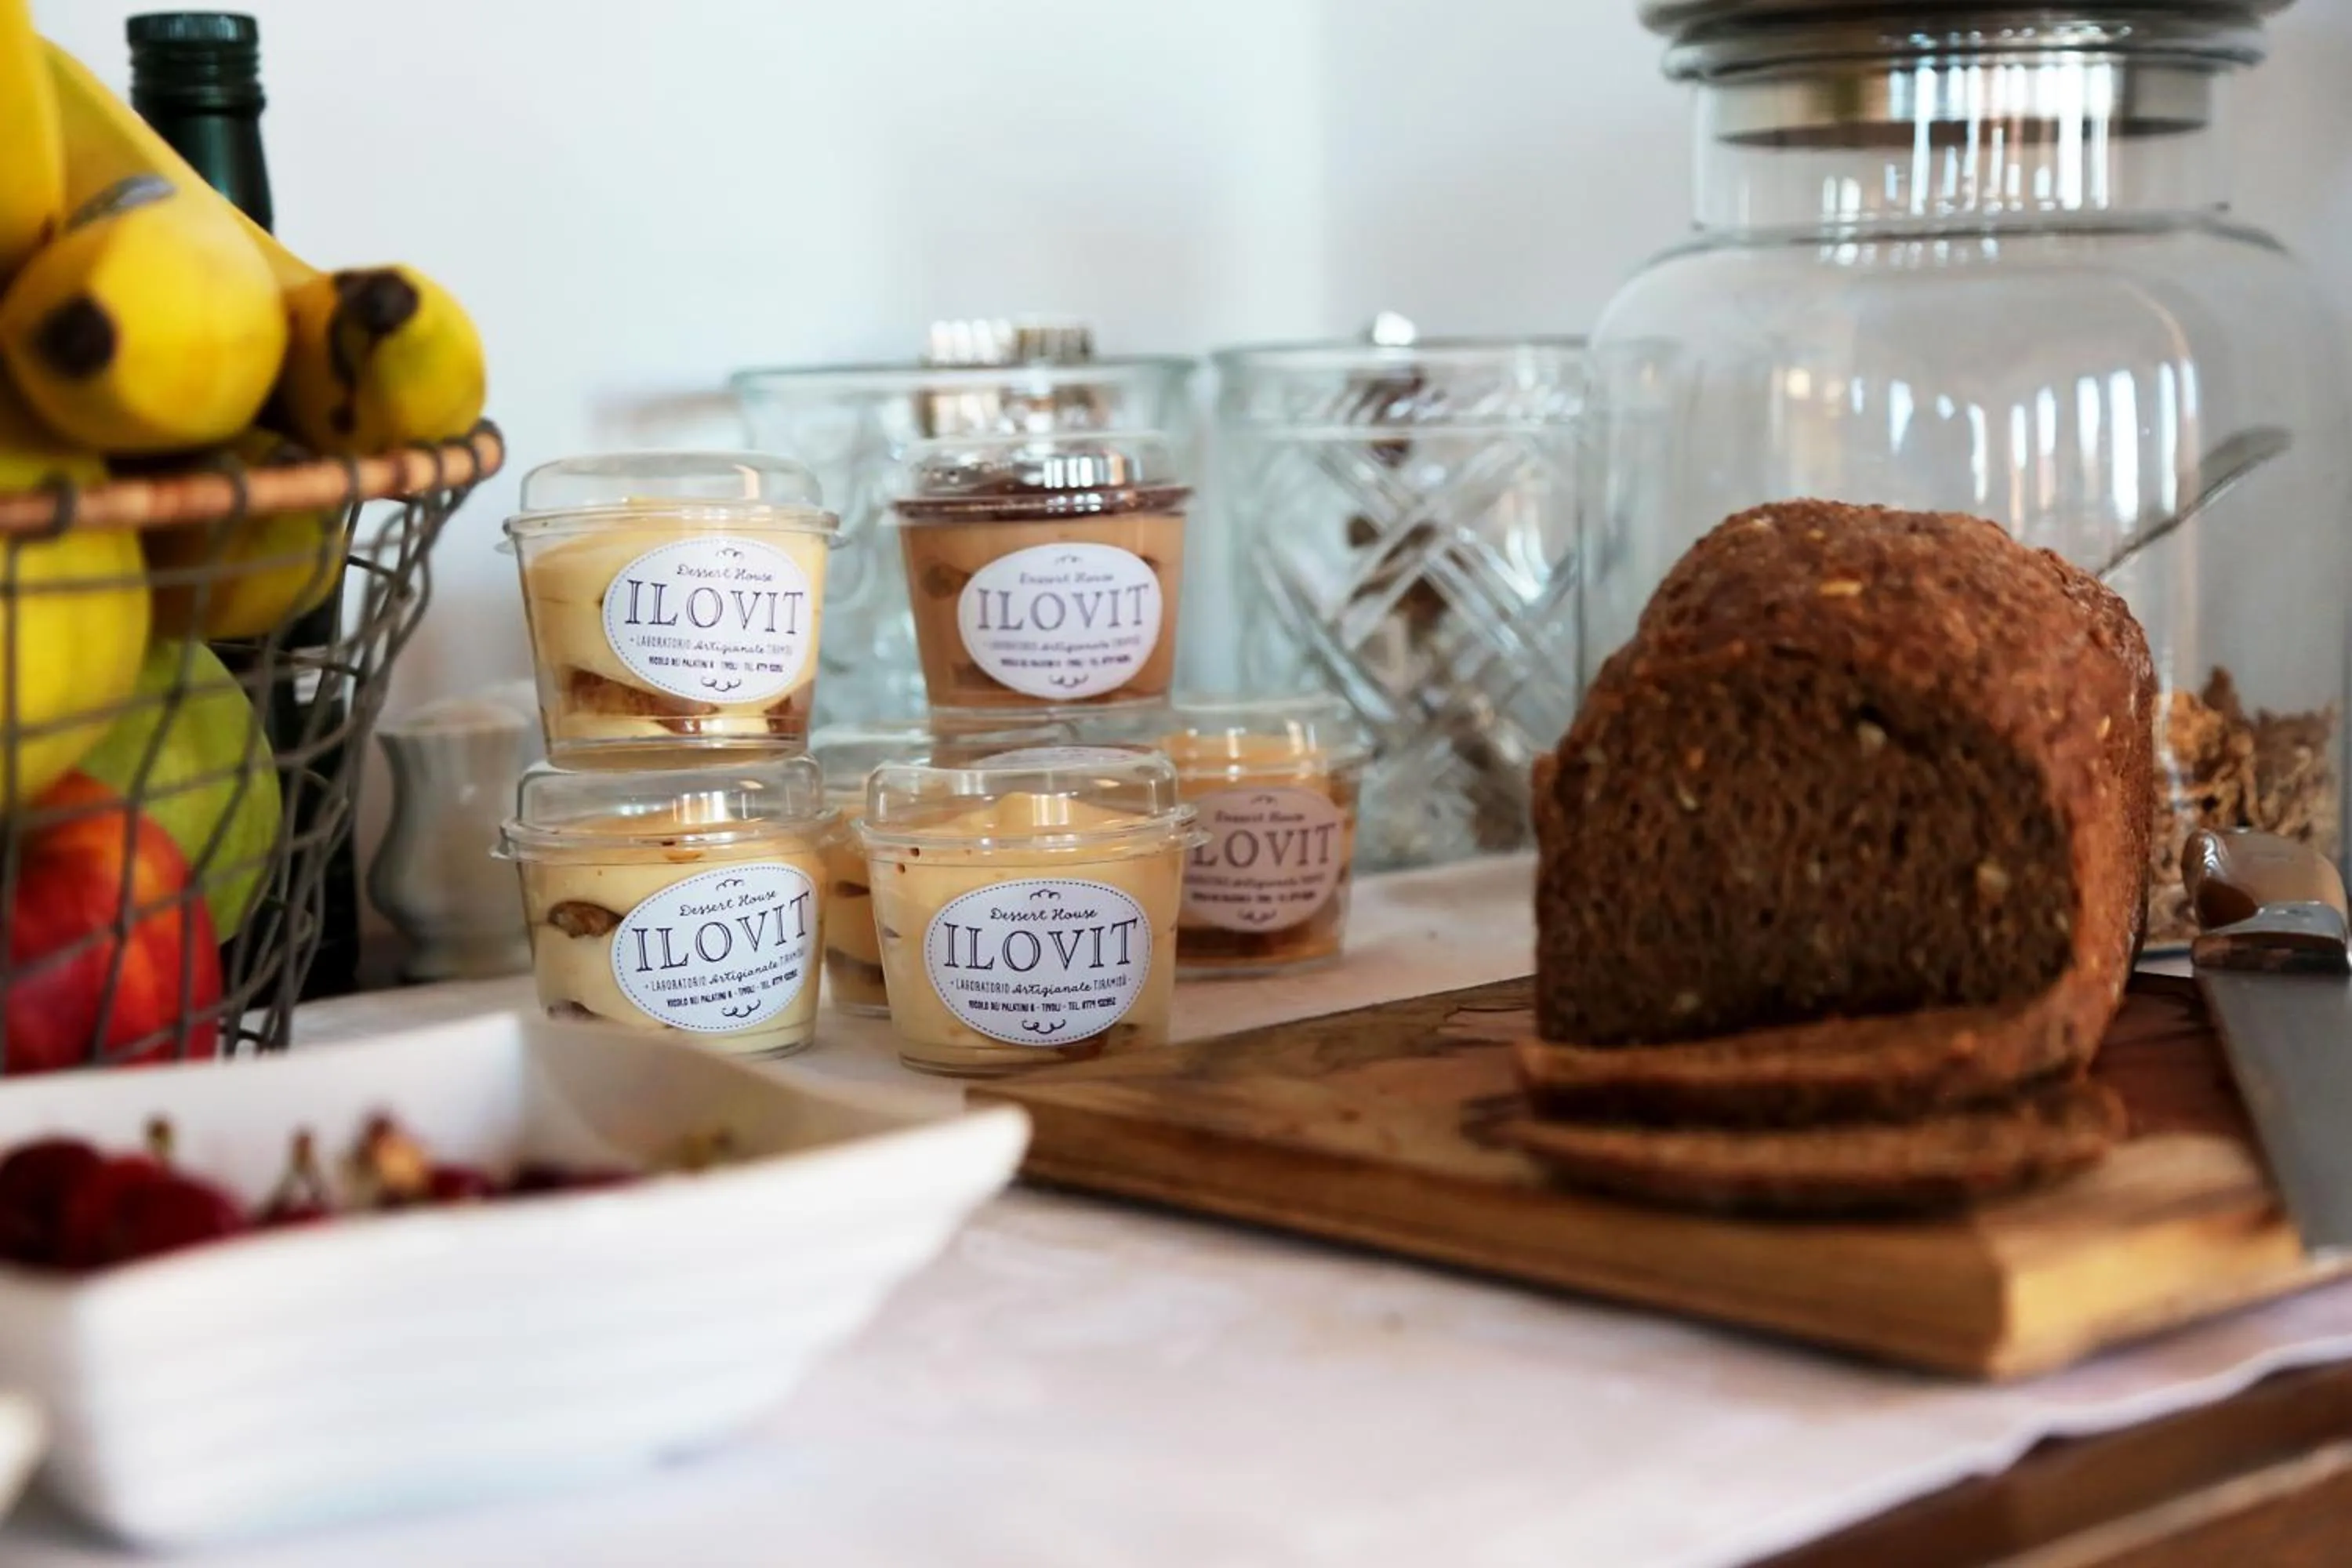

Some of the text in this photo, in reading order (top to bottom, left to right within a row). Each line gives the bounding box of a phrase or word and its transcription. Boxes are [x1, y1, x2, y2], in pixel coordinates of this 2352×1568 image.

[676, 563, 775, 582] Dessert House
[625, 579, 804, 635] ILOVIT
[978, 583, 1150, 632] ILOVIT
[693, 640, 764, 655] Artigianale
[1188, 822, 1337, 868] LOVIT
[679, 890, 779, 916] Dessert House
[990, 907, 1098, 922] Dessert House
[632, 890, 811, 973] ILOVIT
[943, 917, 1138, 972] ILOVIT
[652, 975, 706, 992] LABORATORIO
[708, 960, 778, 985] Artigianale
[956, 978, 1011, 994] LABORATORIO
[1011, 981, 1092, 998] Artigianale
